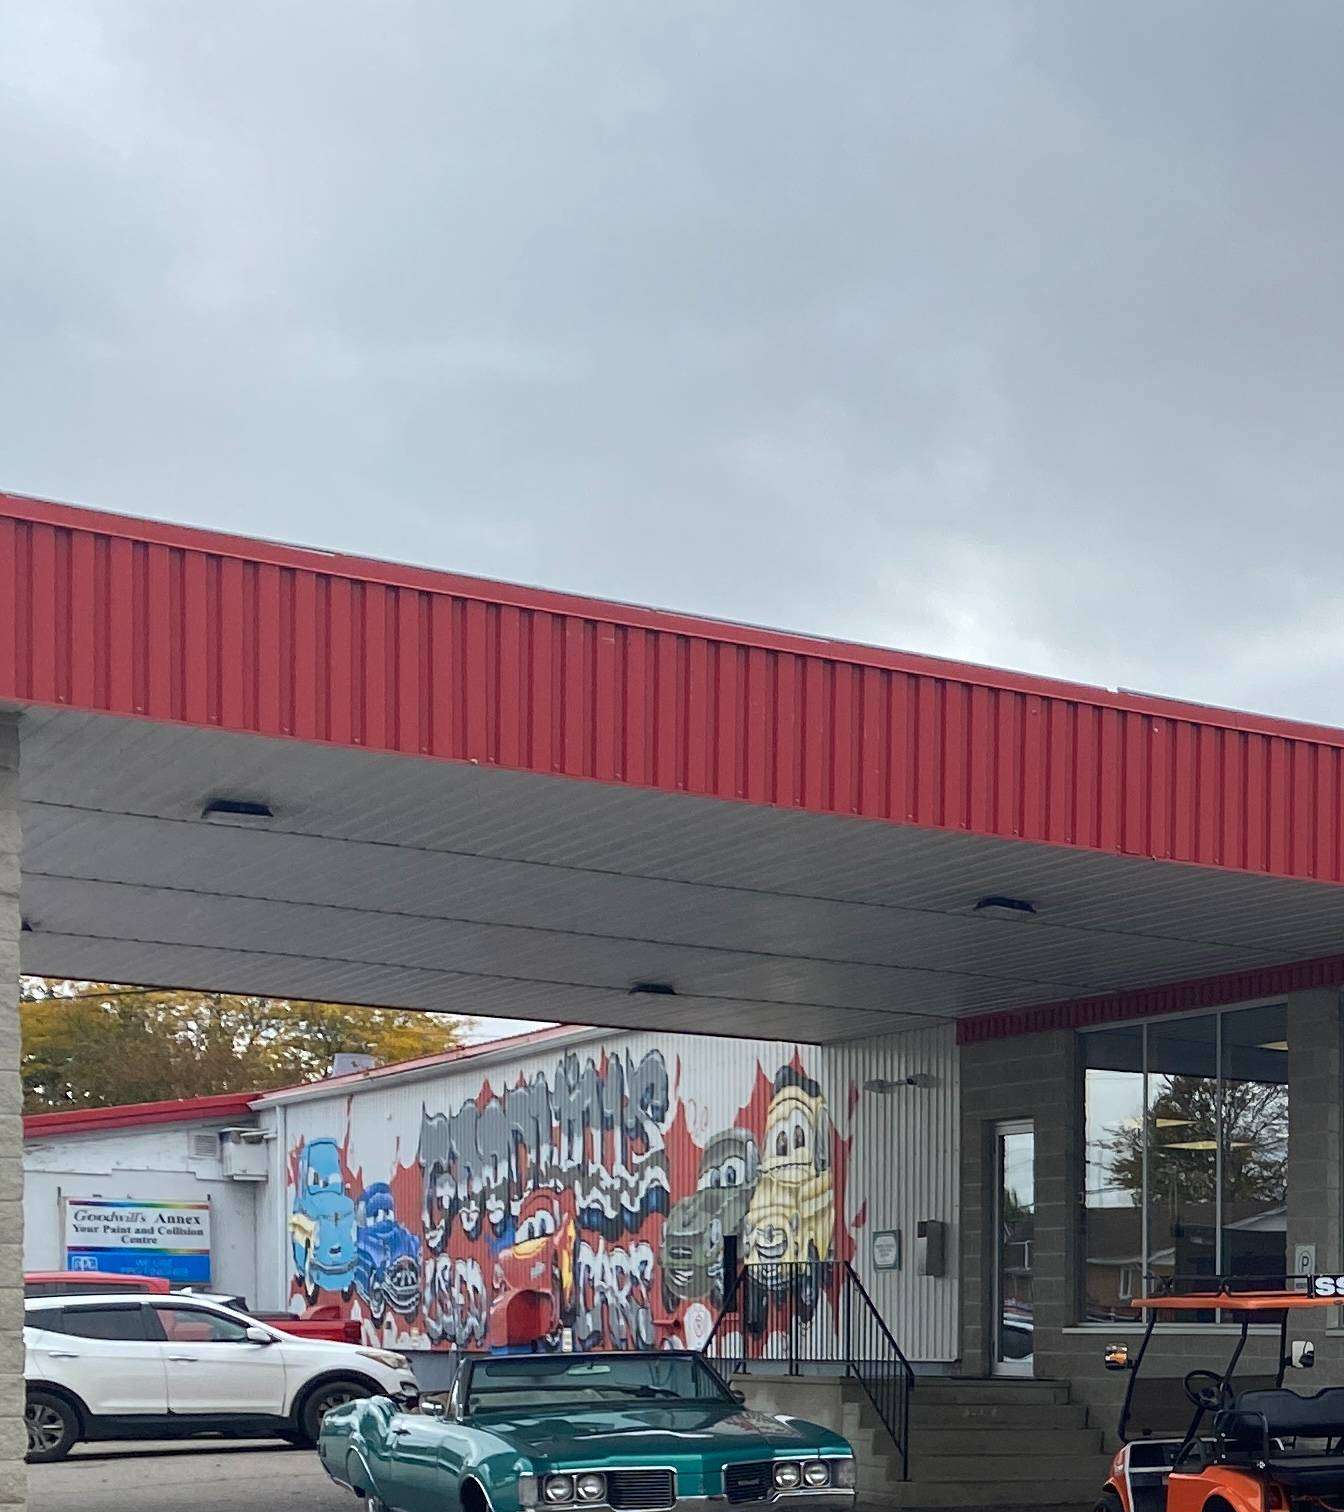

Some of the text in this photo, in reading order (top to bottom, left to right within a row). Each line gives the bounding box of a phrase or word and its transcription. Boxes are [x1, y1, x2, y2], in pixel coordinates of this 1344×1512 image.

[74, 1209, 201, 1225] Goodwill's Annex
[72, 1224, 204, 1236] Your Paint and Collision
[121, 1235, 158, 1244] Centre
